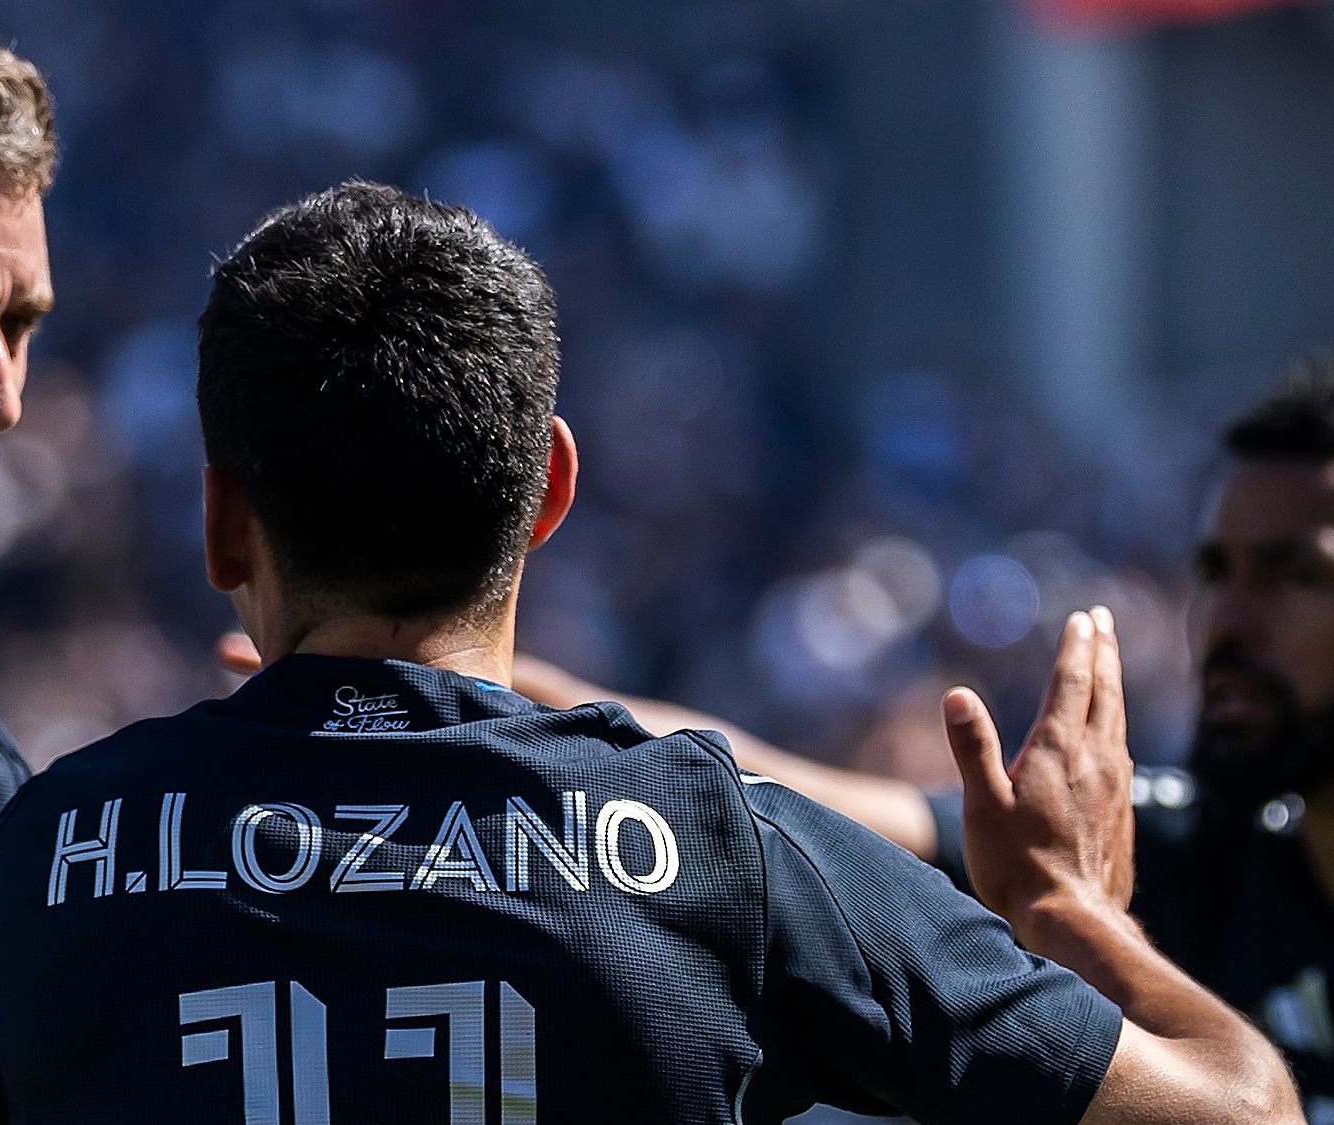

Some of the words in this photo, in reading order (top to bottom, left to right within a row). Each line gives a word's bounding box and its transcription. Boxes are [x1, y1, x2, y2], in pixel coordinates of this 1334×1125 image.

[333, 686, 400, 717] State
[323, 719, 345, 732] of
[347, 710, 411, 734] Flow
[47, 792, 680, 906] H.LOZANO
